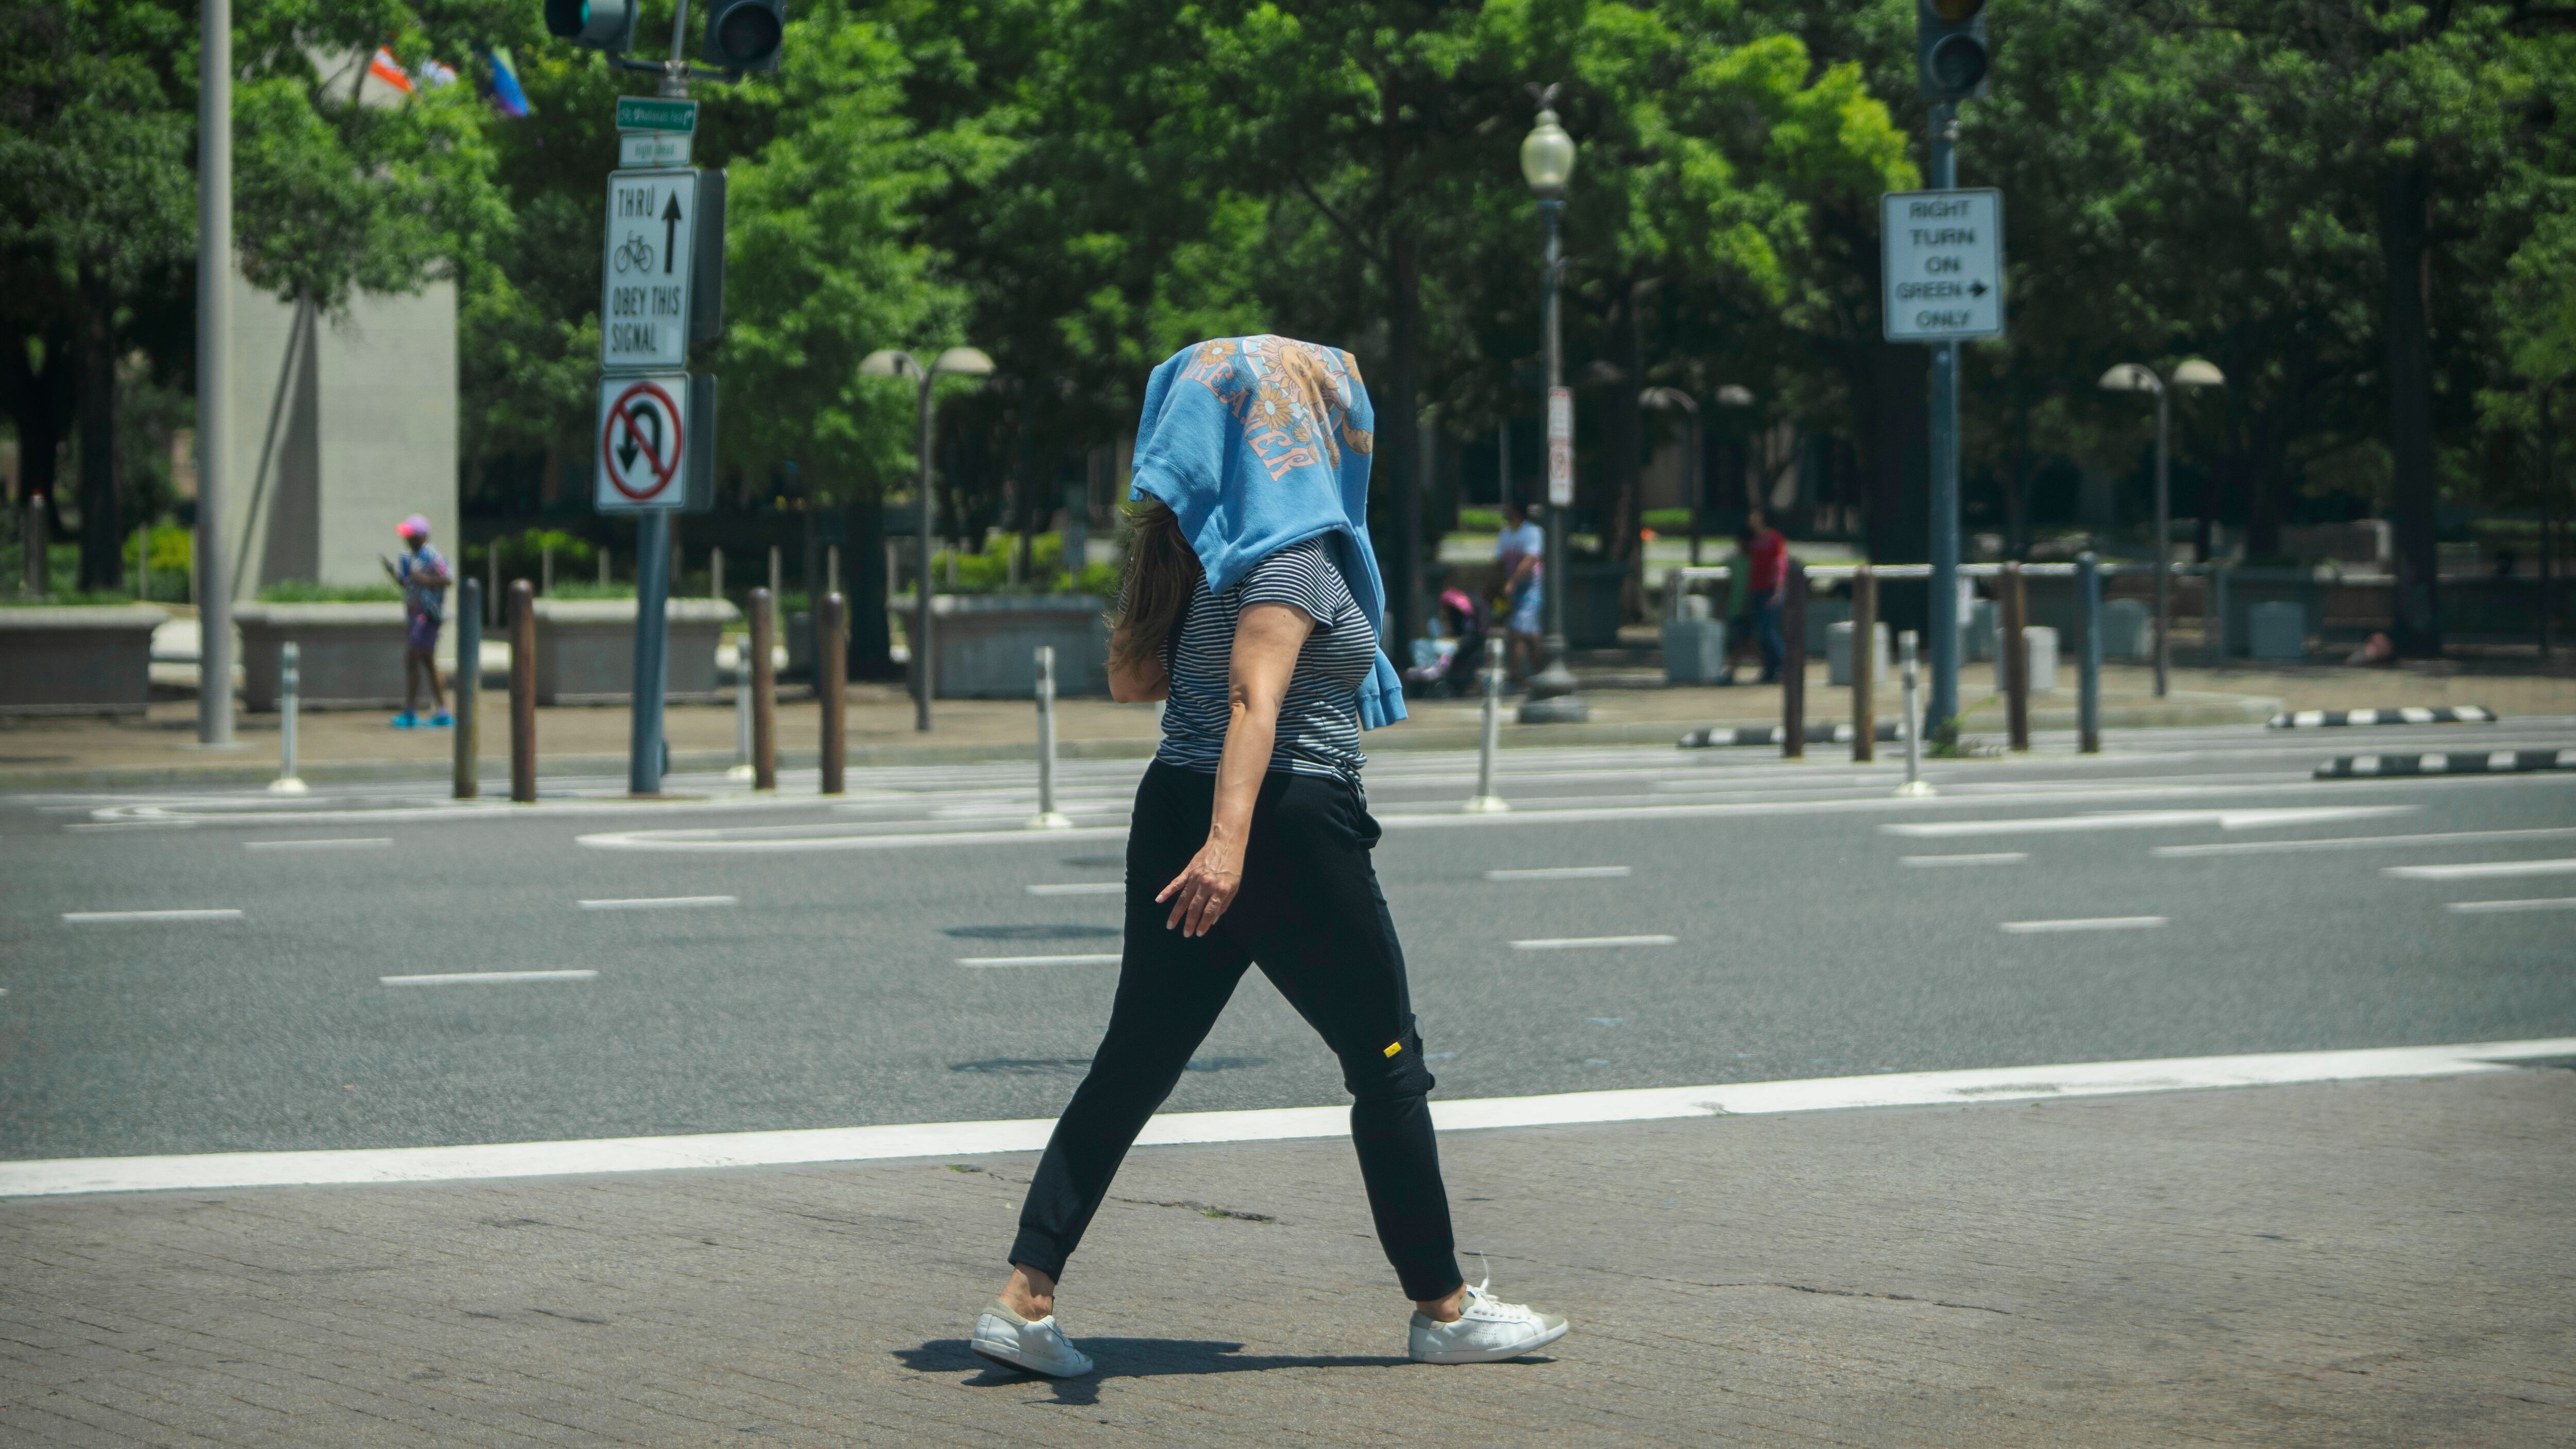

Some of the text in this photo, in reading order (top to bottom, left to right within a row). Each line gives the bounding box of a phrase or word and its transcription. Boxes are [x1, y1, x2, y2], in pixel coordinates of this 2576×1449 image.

[618, 186, 655, 218] THRU
[1909, 200, 1969, 217] RIGHT
[1910, 228, 1975, 245] TURN
[1924, 256, 1960, 275] ON
[1896, 281, 1962, 301] GREEN
[612, 287, 681, 316] OBEY THIS
[1916, 310, 1970, 328] ONLY
[612, 323, 657, 353] SIGNAL
